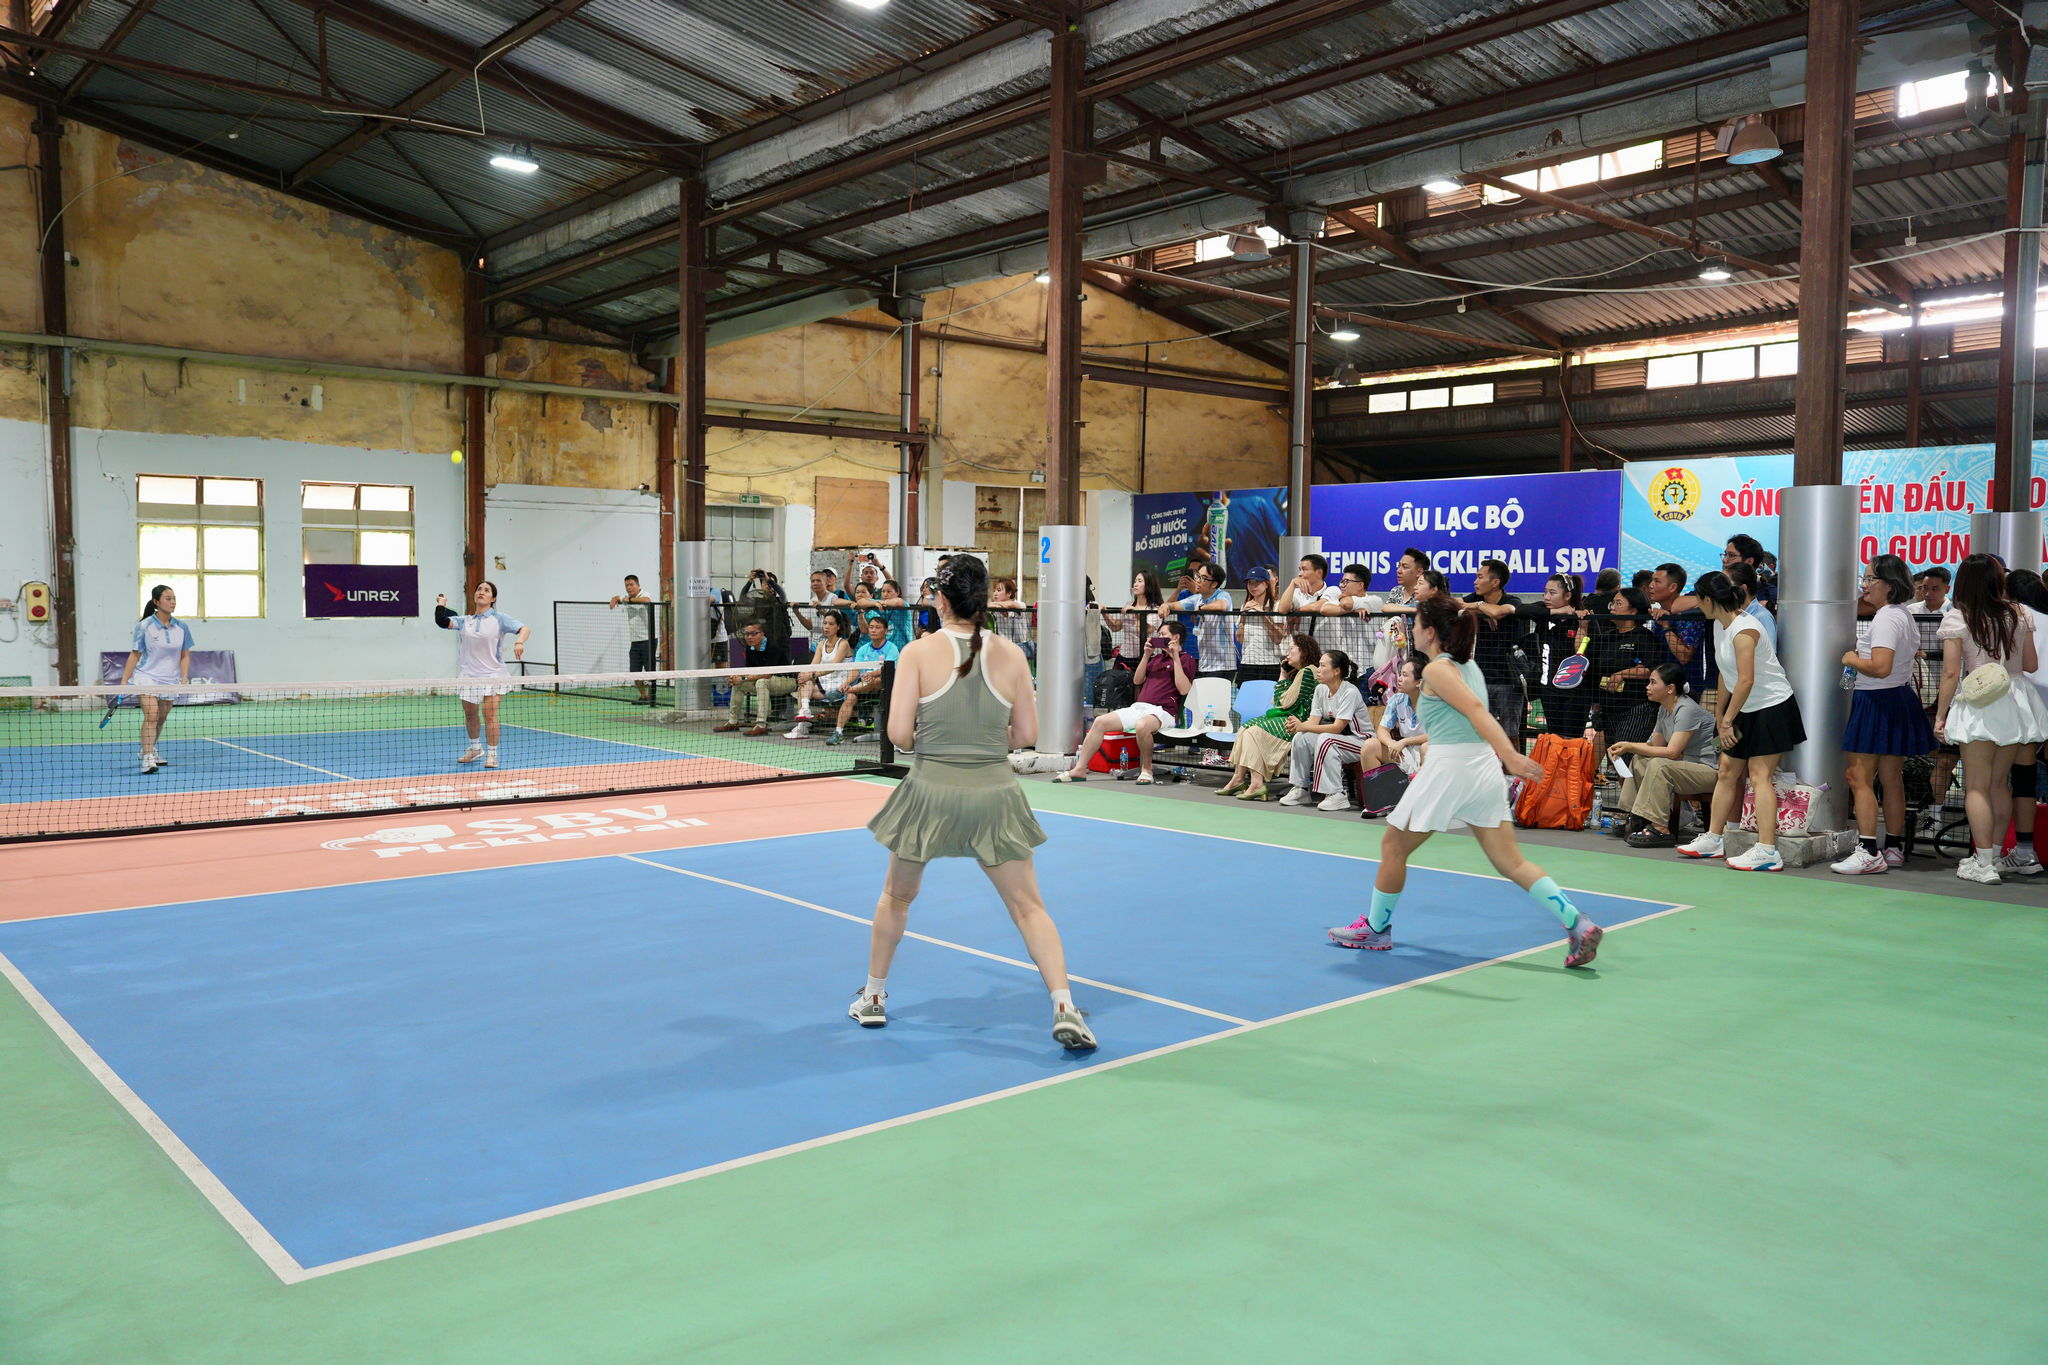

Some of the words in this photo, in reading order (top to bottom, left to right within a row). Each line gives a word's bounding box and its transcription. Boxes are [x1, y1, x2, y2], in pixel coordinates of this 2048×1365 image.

[1903, 471, 1975, 514] ĐẤU,
[1150, 521, 1161, 535] BÙ
[1162, 518, 1187, 534] NƯỚC
[1384, 502, 1429, 532] CÂU
[1434, 505, 1479, 538] LẠC
[1485, 498, 1525, 536] BỘ
[1041, 536, 1051, 563] 2
[1135, 535, 1148, 552] BỔ
[1149, 536, 1170, 550] SUNG
[1171, 533, 1188, 546] ION
[1889, 532, 1971, 565] GƯƠN
[1321, 551, 1391, 574] ENNIS
[1425, 549, 1549, 574] CKLEBALL
[1555, 547, 1606, 574] SBV
[347, 590, 400, 602] UNREX
[466, 804, 668, 836] SBV
[370, 817, 711, 859] PickleBall
